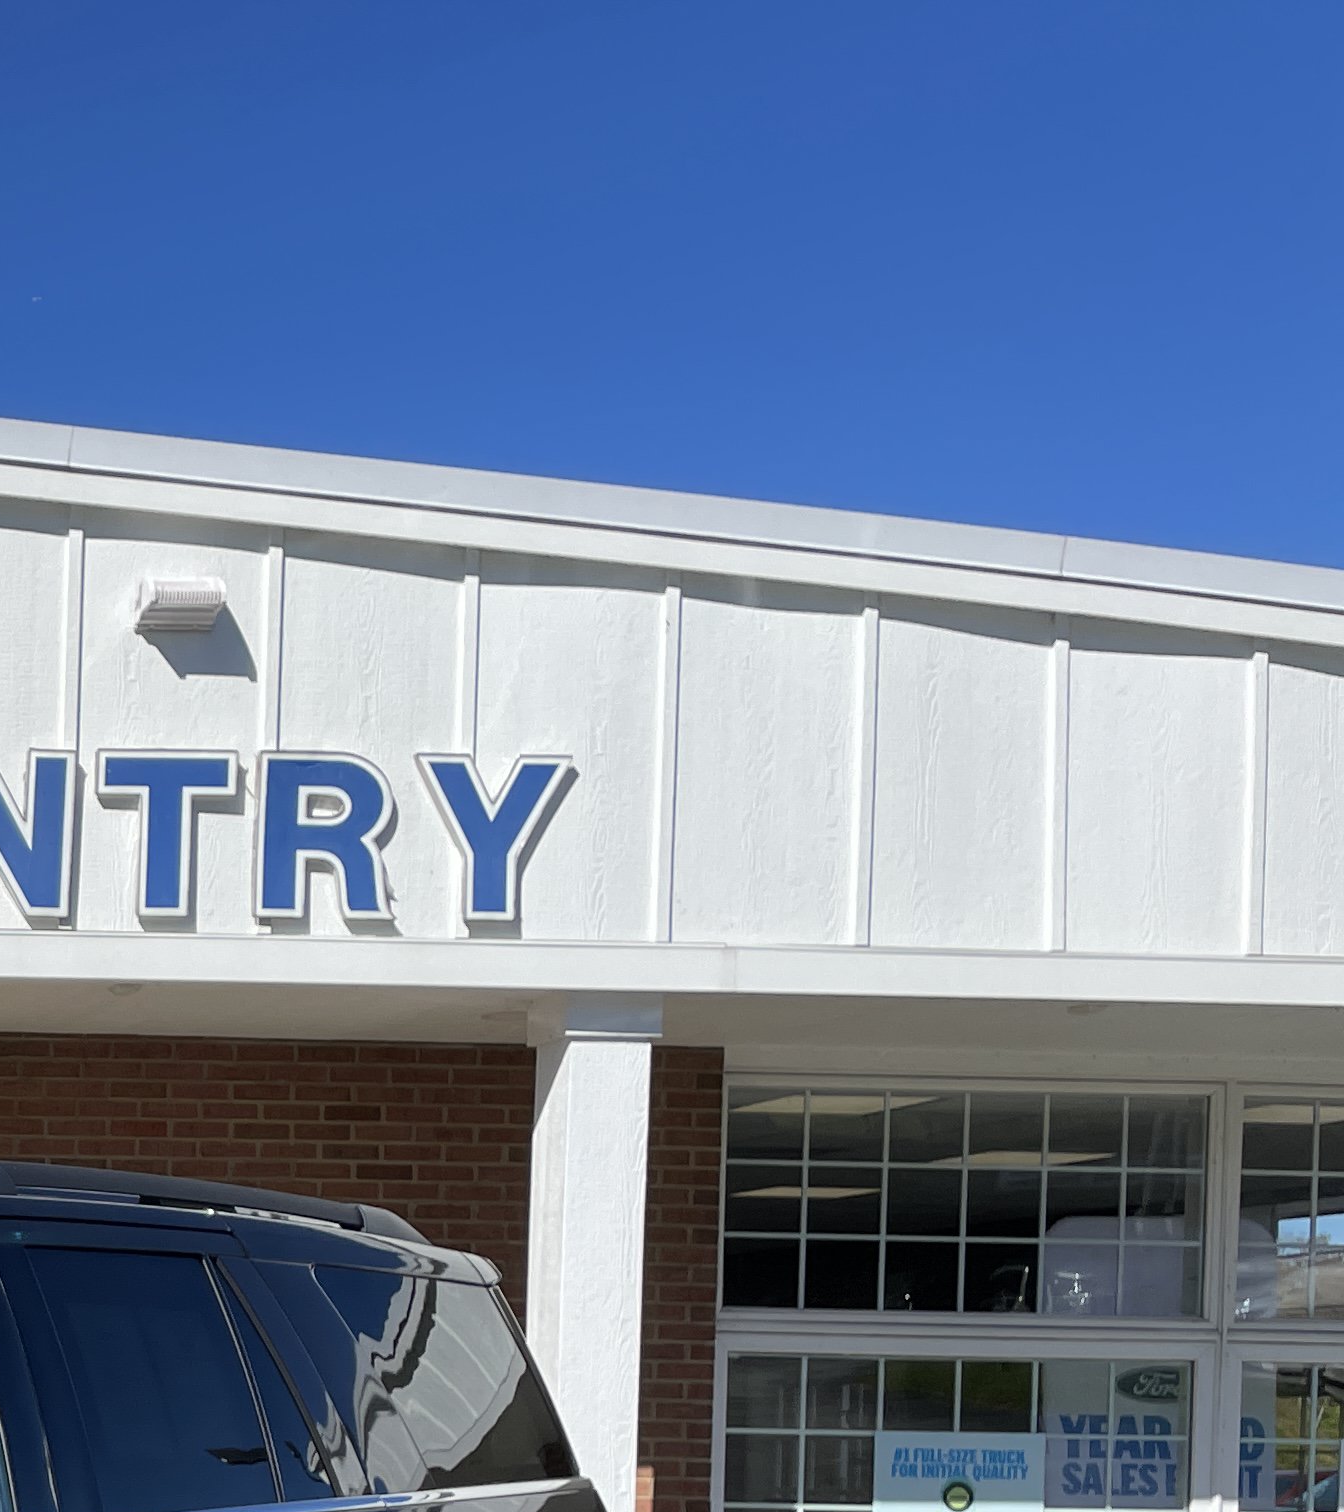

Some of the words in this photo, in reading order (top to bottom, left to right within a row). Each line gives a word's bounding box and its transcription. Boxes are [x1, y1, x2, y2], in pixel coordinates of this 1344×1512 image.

[1060, 1414, 1172, 1459] YEAR
[913, 1448, 976, 1464] FULL-SIZE
[981, 1449, 1026, 1465] TRUCK
[891, 1463, 918, 1478] FOR
[921, 1463, 967, 1479] INITIAL
[972, 1464, 1029, 1482] QUALITY
